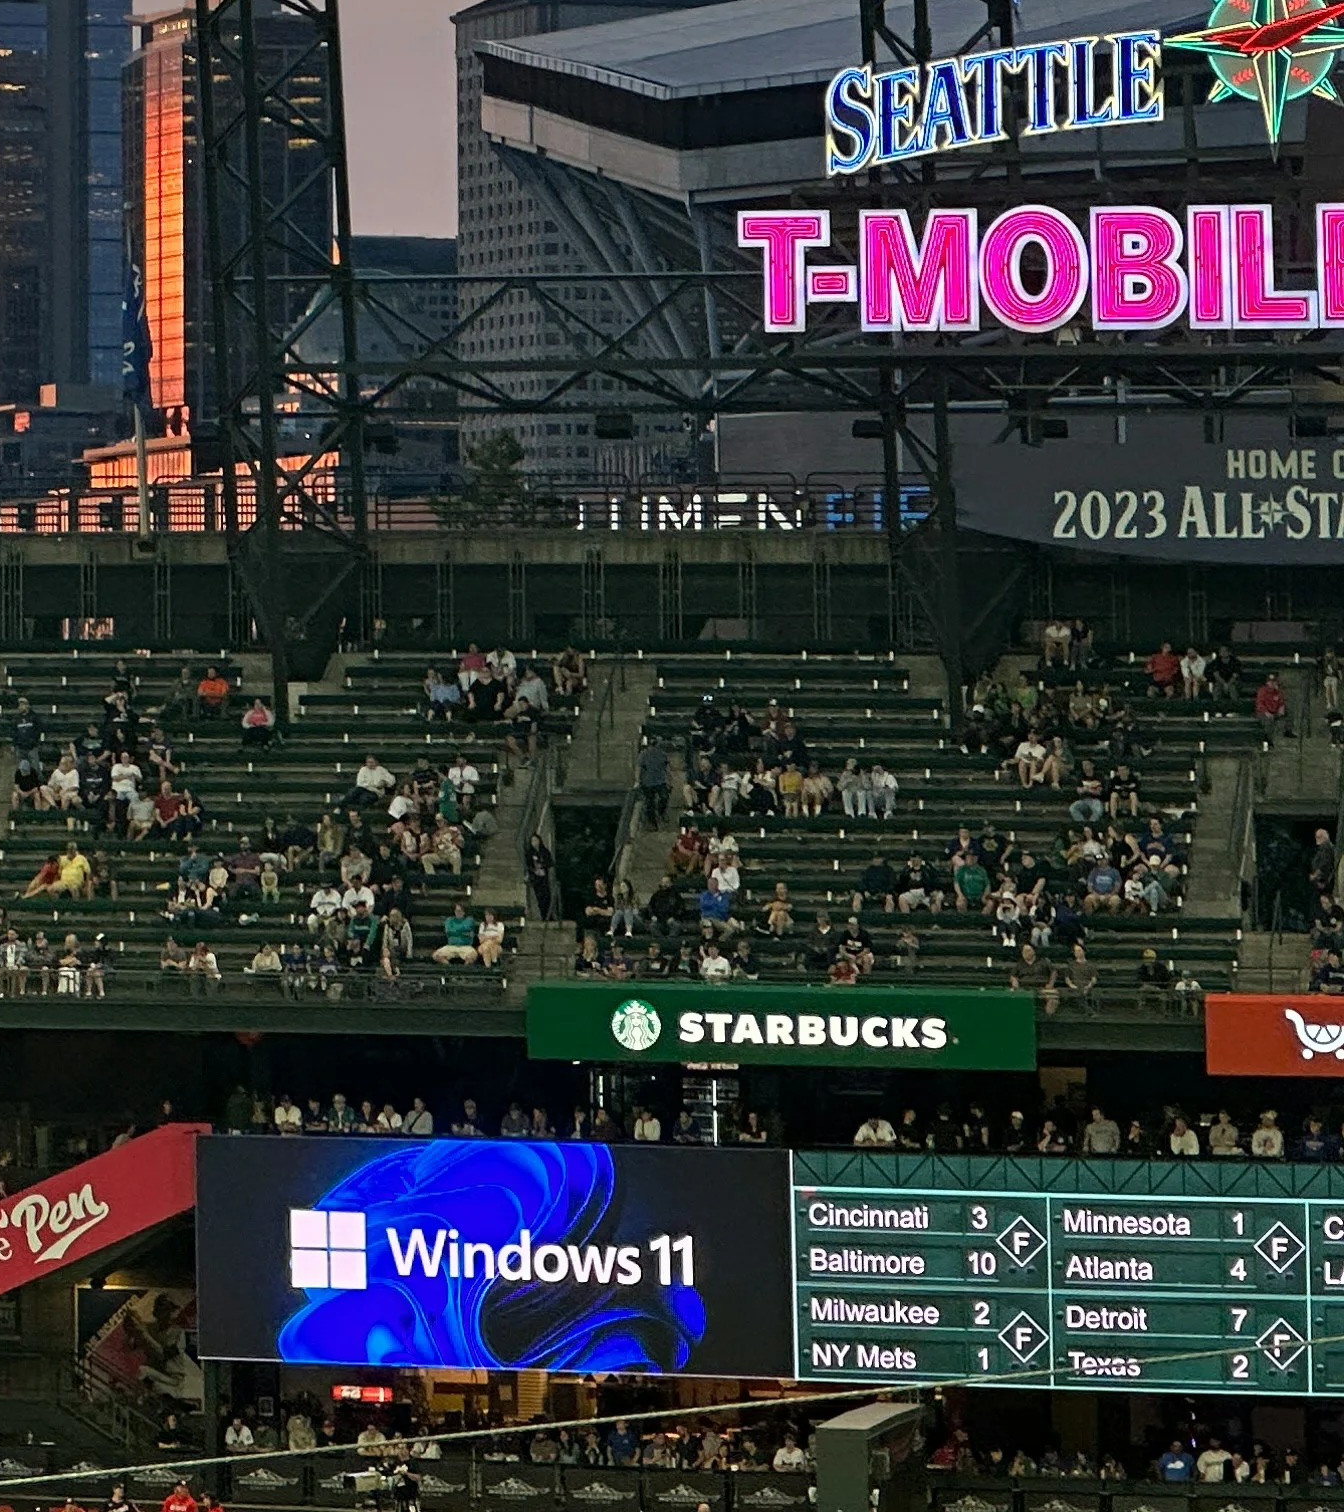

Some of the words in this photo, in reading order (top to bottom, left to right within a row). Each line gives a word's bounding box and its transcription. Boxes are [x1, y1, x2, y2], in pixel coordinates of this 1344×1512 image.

[825, 30, 1164, 179] SEATTLE
[1227, 450, 1316, 479] HOME
[1053, 491, 1167, 539] 2023
[680, 1012, 947, 1048] STARBUCKS
[809, 1203, 929, 1230] Cincinnati
[972, 1207, 988, 1229] 3
[1063, 1209, 1191, 1236] Minnesota
[1232, 1212, 1244, 1235] 1
[386, 1227, 642, 1285] Windows
[649, 1235, 694, 1286] 11
[1012, 1232, 1030, 1255] F
[1271, 1238, 1289, 1261] F
[810, 1248, 925, 1274] Baltimore
[968, 1252, 996, 1275] 10
[1066, 1256, 1153, 1280] Atlanta
[1230, 1258, 1247, 1281] 4
[811, 1297, 939, 1325] Milwaukee
[974, 1302, 990, 1325] 2
[1066, 1305, 1147, 1330] Detroit
[1232, 1309, 1248, 1331] 7
[1015, 1327, 1033, 1350] F
[1272, 1334, 1291, 1357] F
[812, 1343, 850, 1367] NY
[857, 1345, 916, 1369] Mets
[977, 1347, 988, 1370] 1
[1068, 1351, 1141, 1377] Texas
[1232, 1355, 1248, 1378] 2
